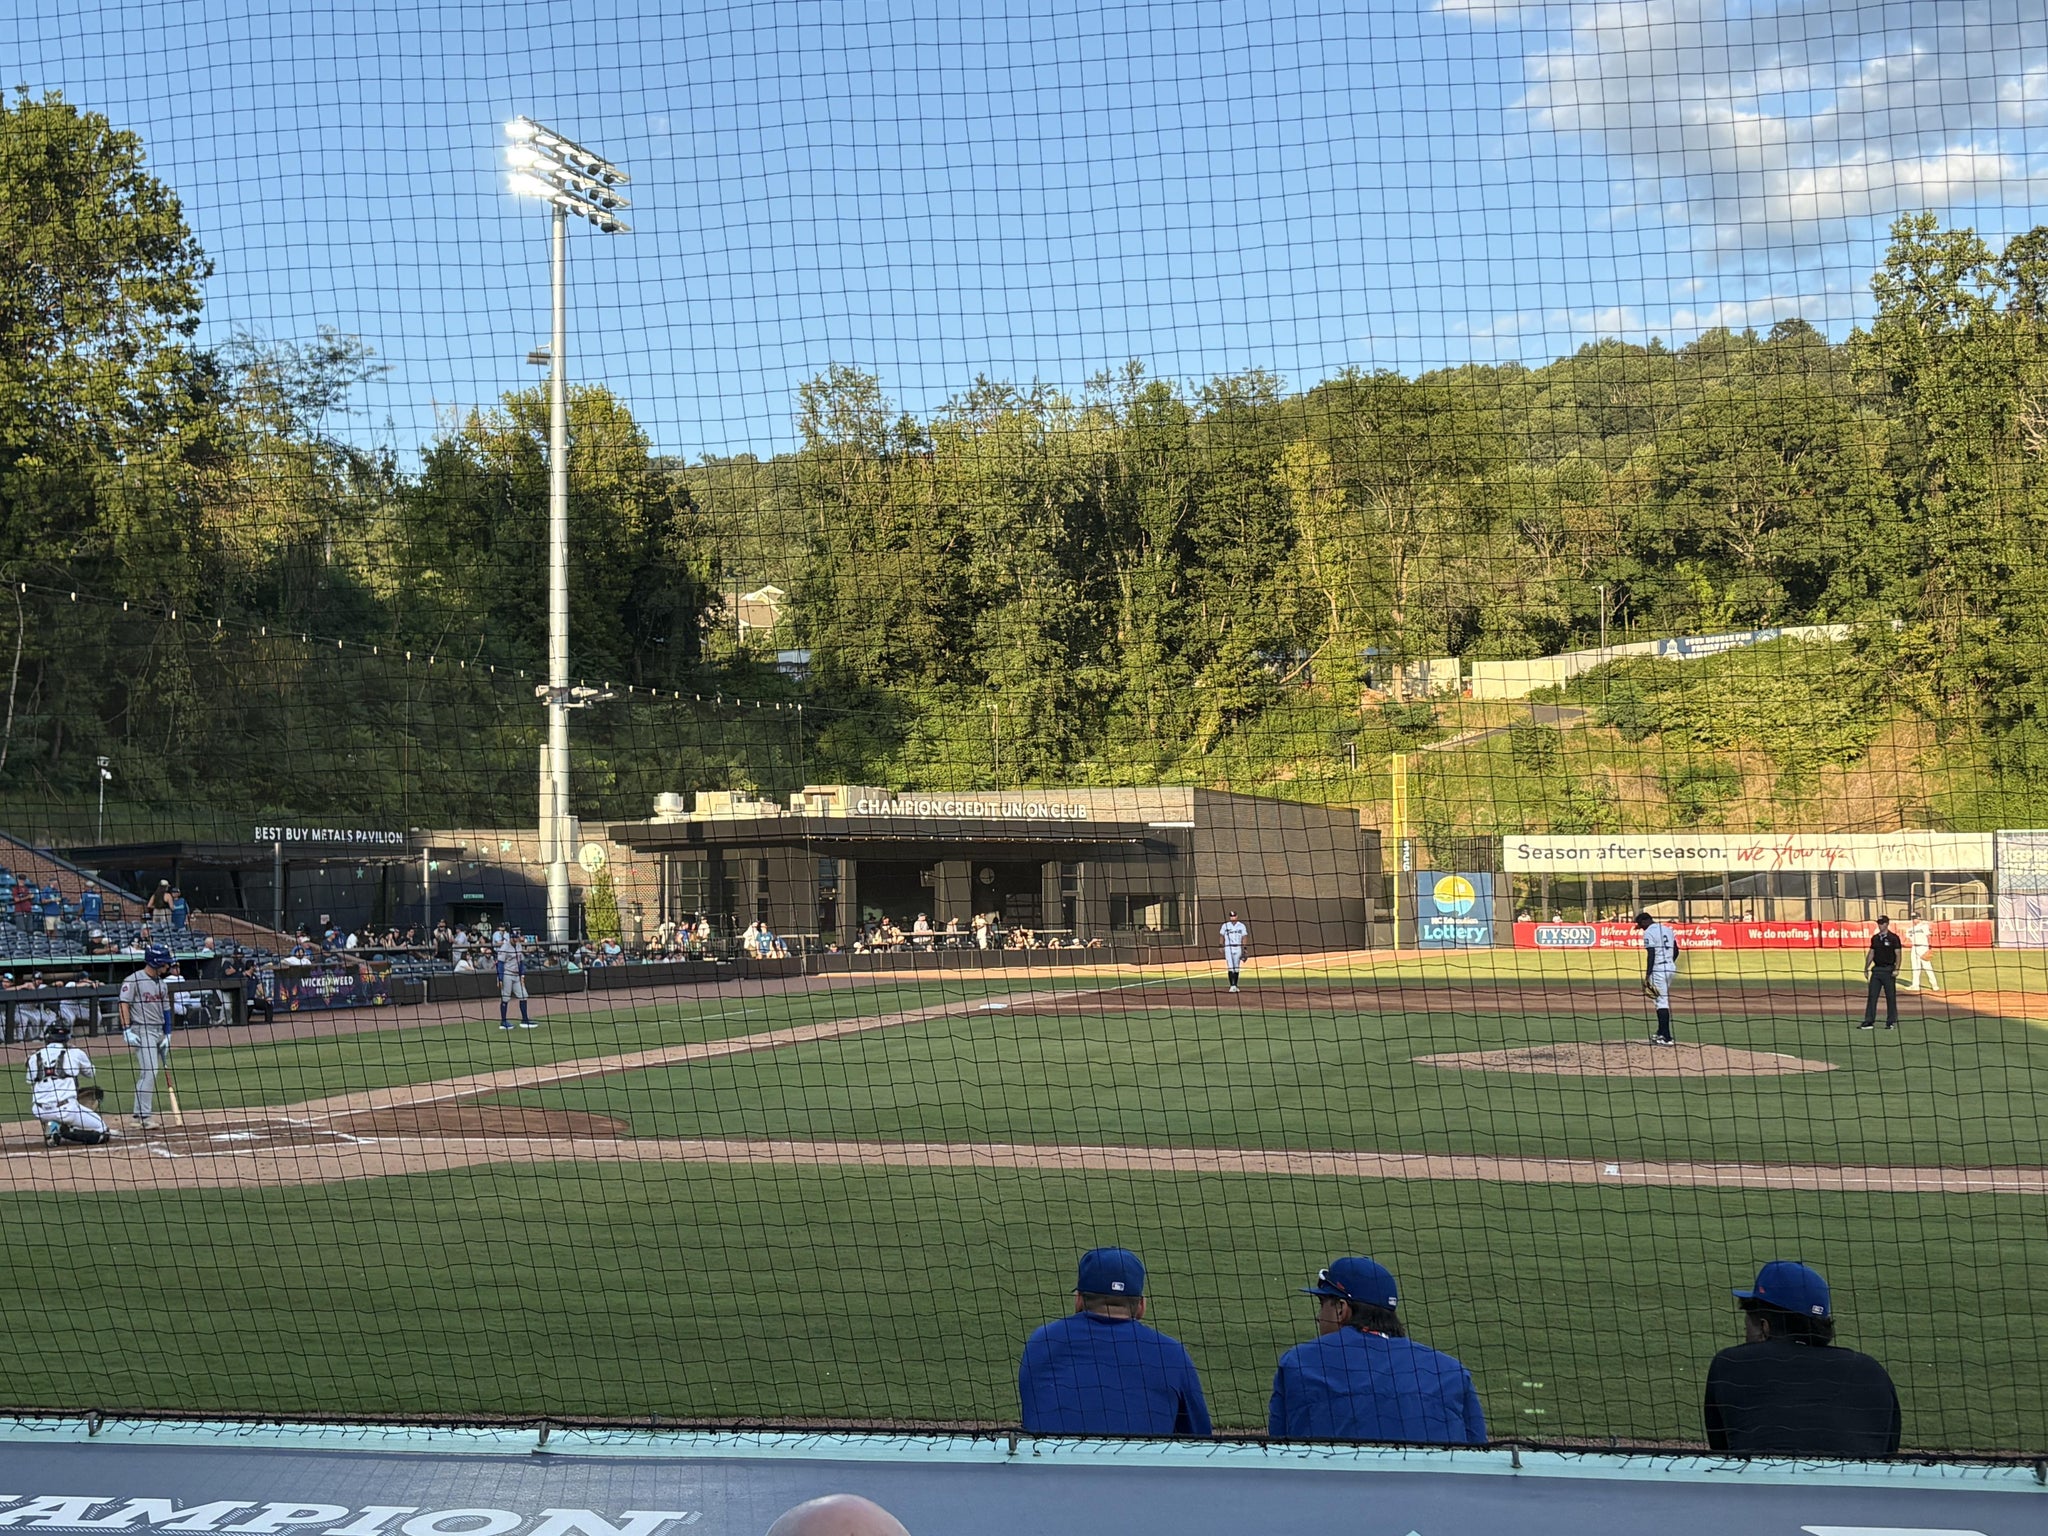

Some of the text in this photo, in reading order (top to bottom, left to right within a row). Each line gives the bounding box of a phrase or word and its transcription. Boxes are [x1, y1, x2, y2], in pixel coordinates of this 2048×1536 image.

[857, 799, 1087, 818] CHAMPION CREDIT UNION CLUB
[255, 827, 403, 844] BEST BUY METALS PAVILION
[1518, 843, 1590, 860] Season
[1598, 843, 1646, 860] after
[1652, 845, 1728, 861] season.
[1737, 840, 1765, 861] We
[1424, 924, 1488, 943] Lottery
[1539, 928, 1591, 939] TYSON
[1601, 926, 1628, 937] Where
[1695, 926, 1717, 937] begin
[1748, 929, 1763, 939] We
[1764, 929, 1776, 939] do
[1813, 928, 1828, 938] We
[1828, 928, 1840, 938] do
[1600, 938, 1625, 947] Since
[1681, 938, 1722, 947] Mountain
